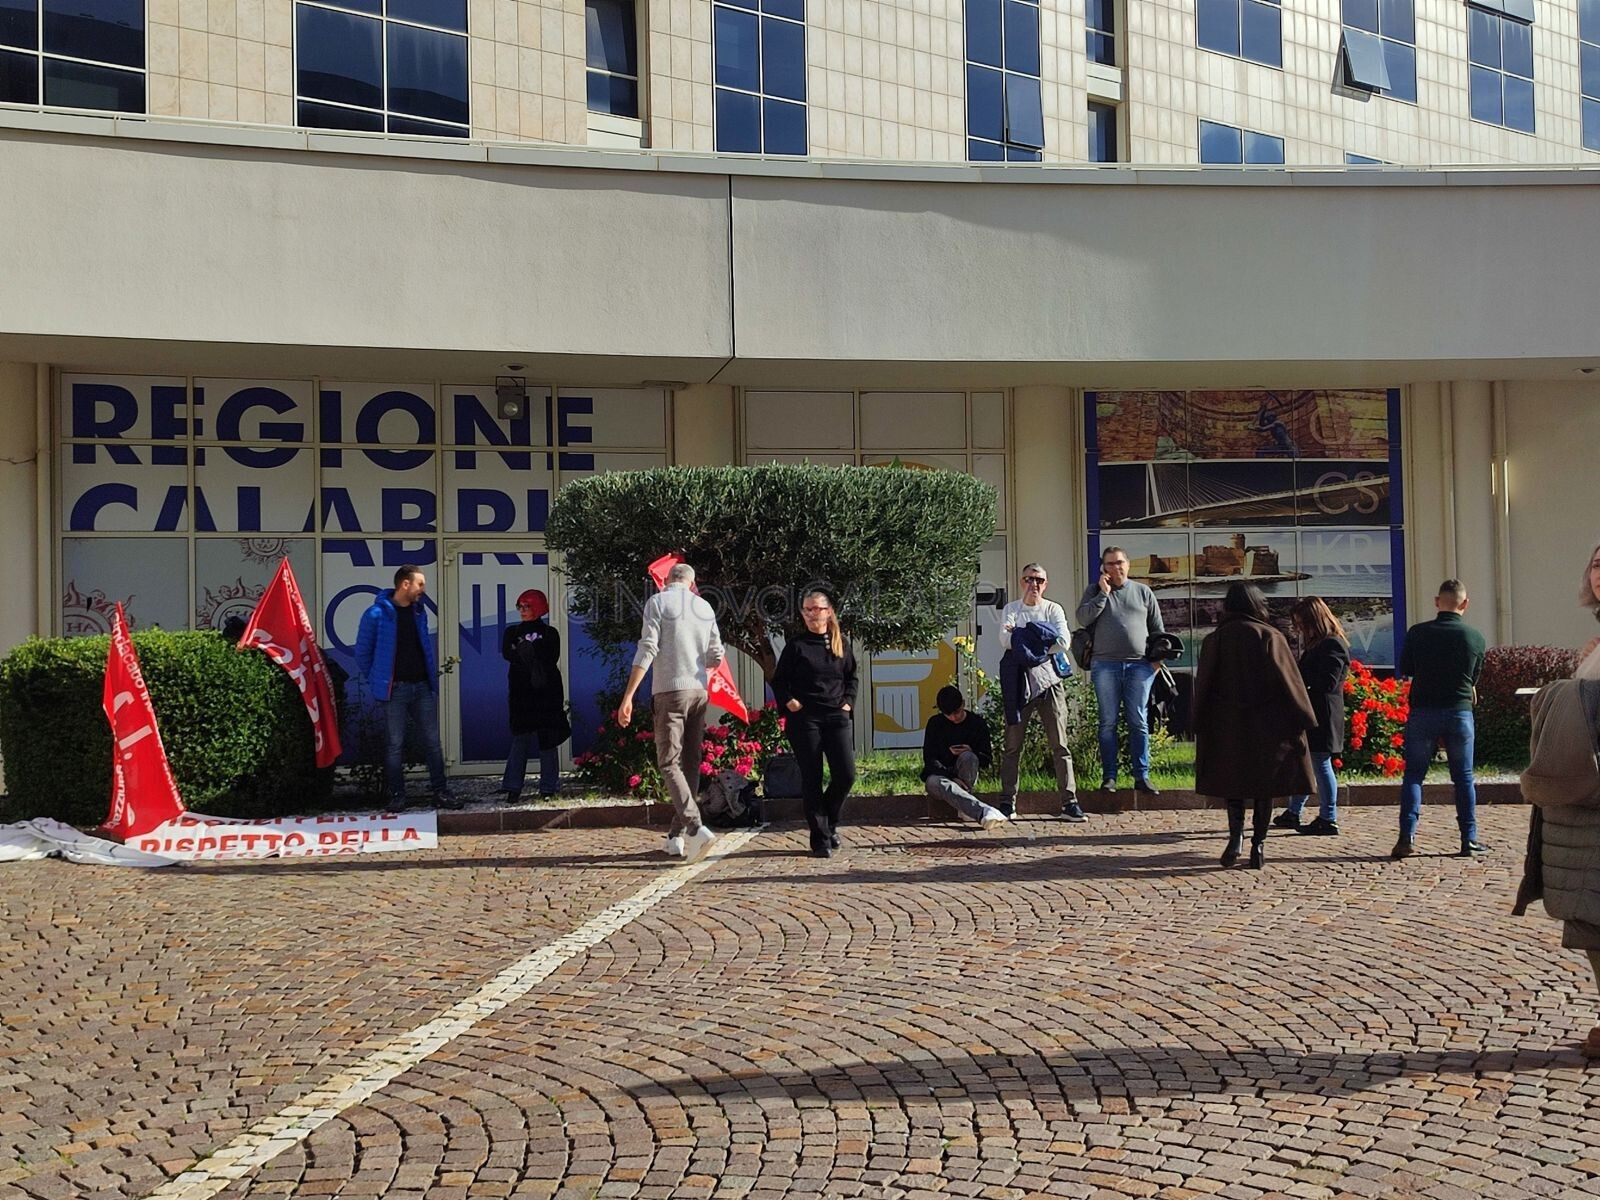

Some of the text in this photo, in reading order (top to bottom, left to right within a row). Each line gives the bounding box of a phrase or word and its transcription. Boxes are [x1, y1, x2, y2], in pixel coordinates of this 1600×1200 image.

[72, 384, 594, 471] REGIONE
[1313, 471, 1379, 514] CS
[70, 483, 549, 569] CALABRI
[1316, 533, 1377, 575] KR
